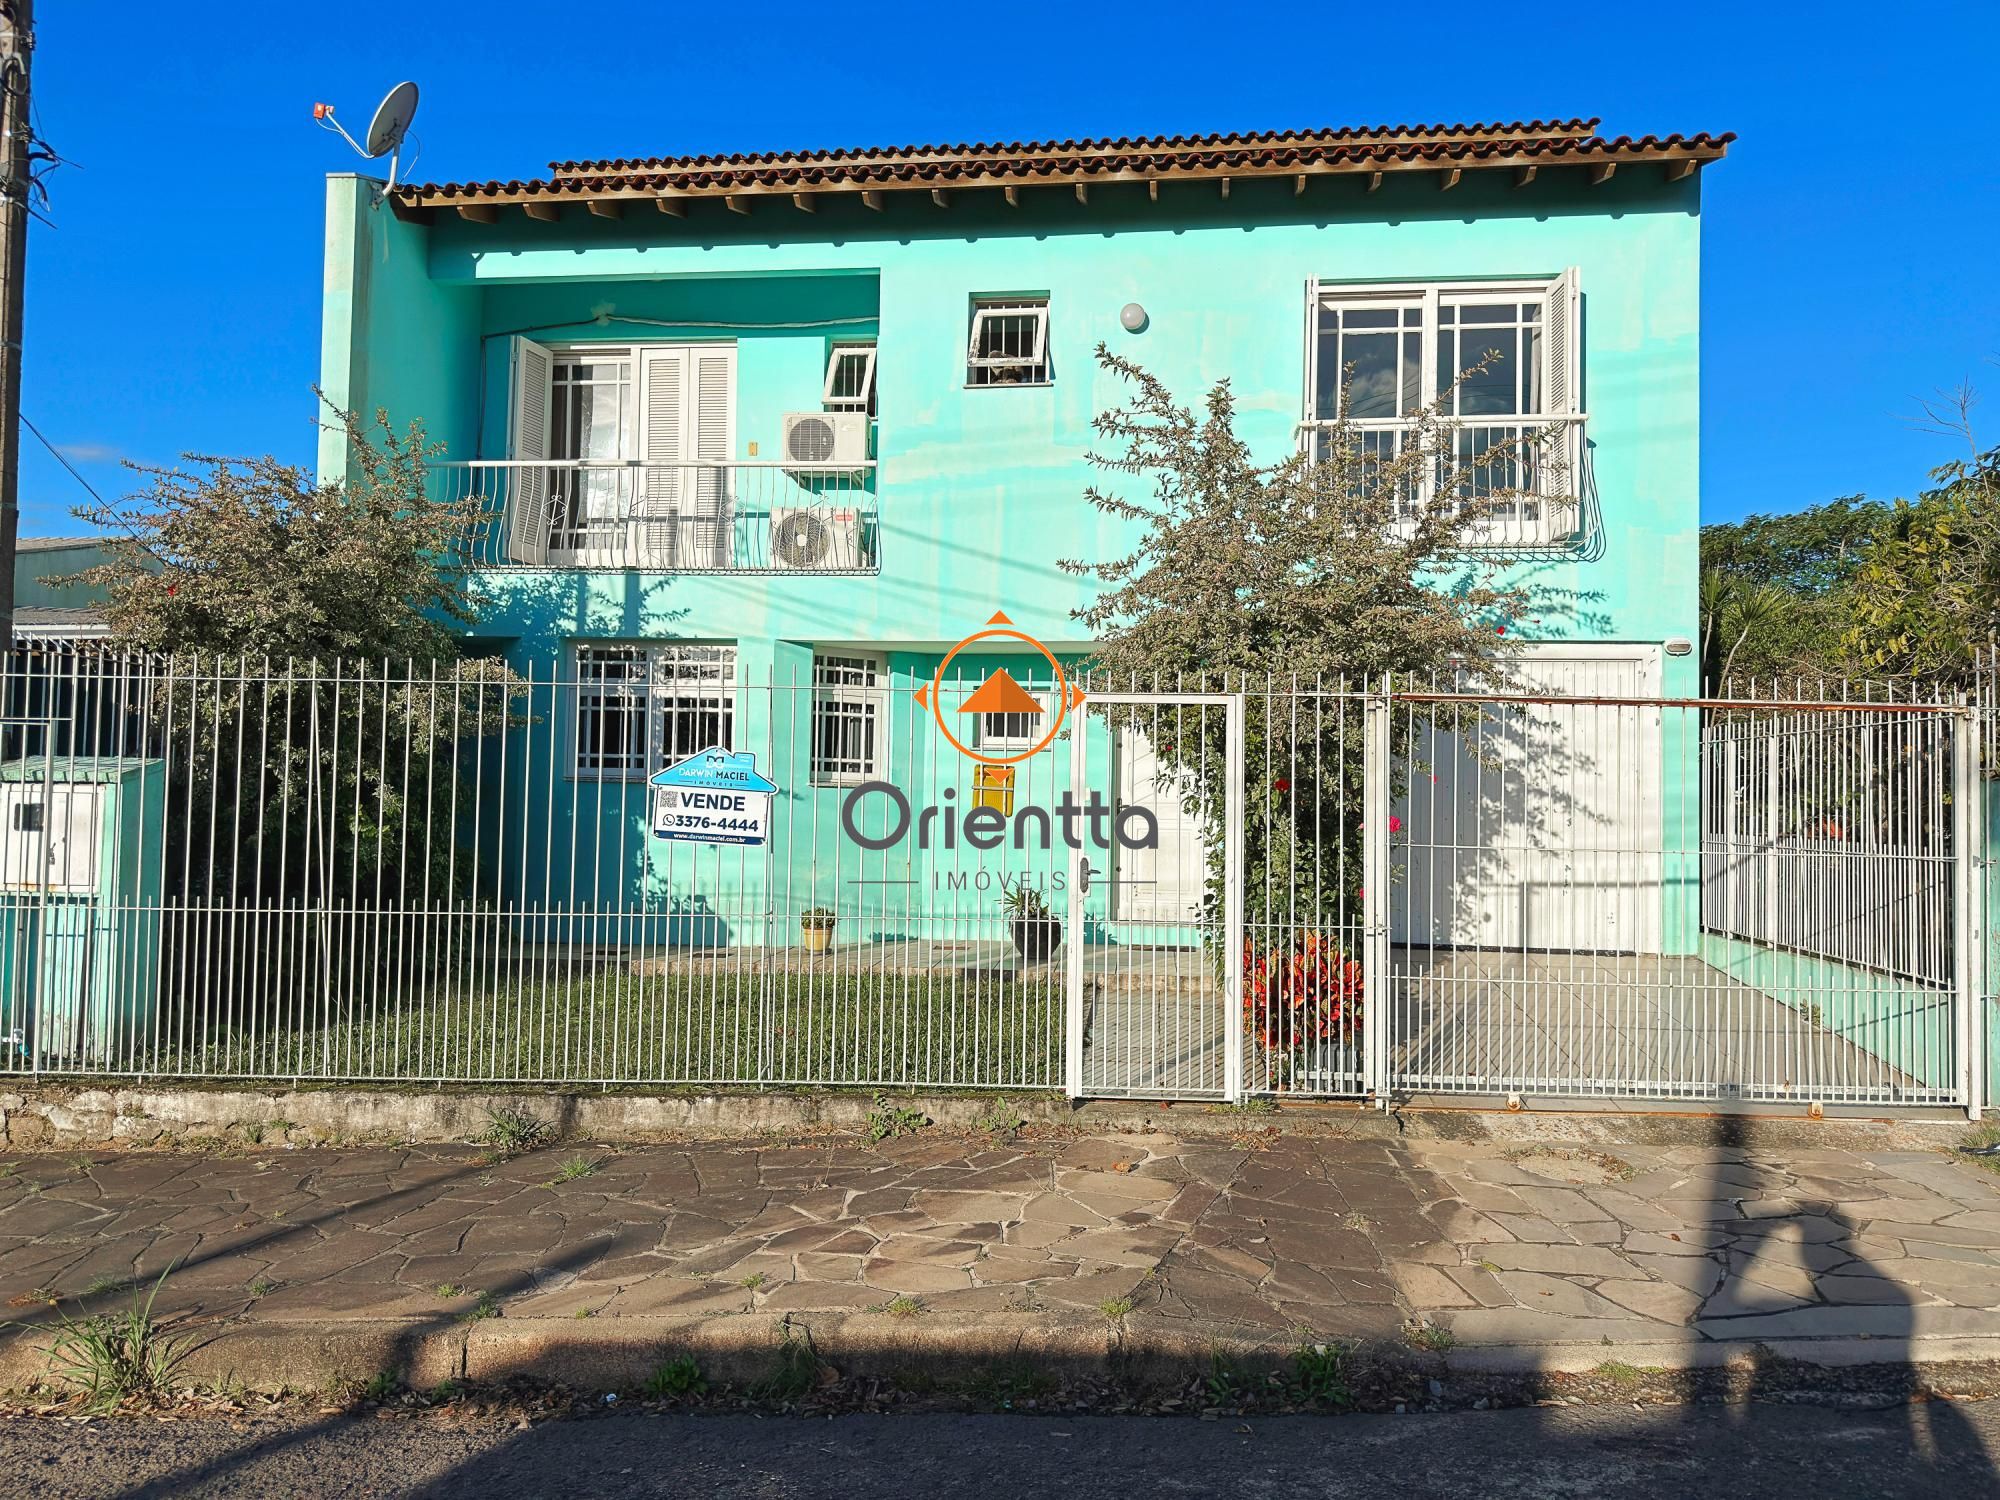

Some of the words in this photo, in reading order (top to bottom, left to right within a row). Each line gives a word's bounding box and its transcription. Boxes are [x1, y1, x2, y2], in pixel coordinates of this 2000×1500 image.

[679, 768, 713, 778] DARWIN
[716, 771, 750, 781] MACIEL
[681, 792, 746, 811] VENDE
[675, 815, 759, 832] 3376-4444
[674, 833, 746, 843] www.darwinmaciel.com.br
